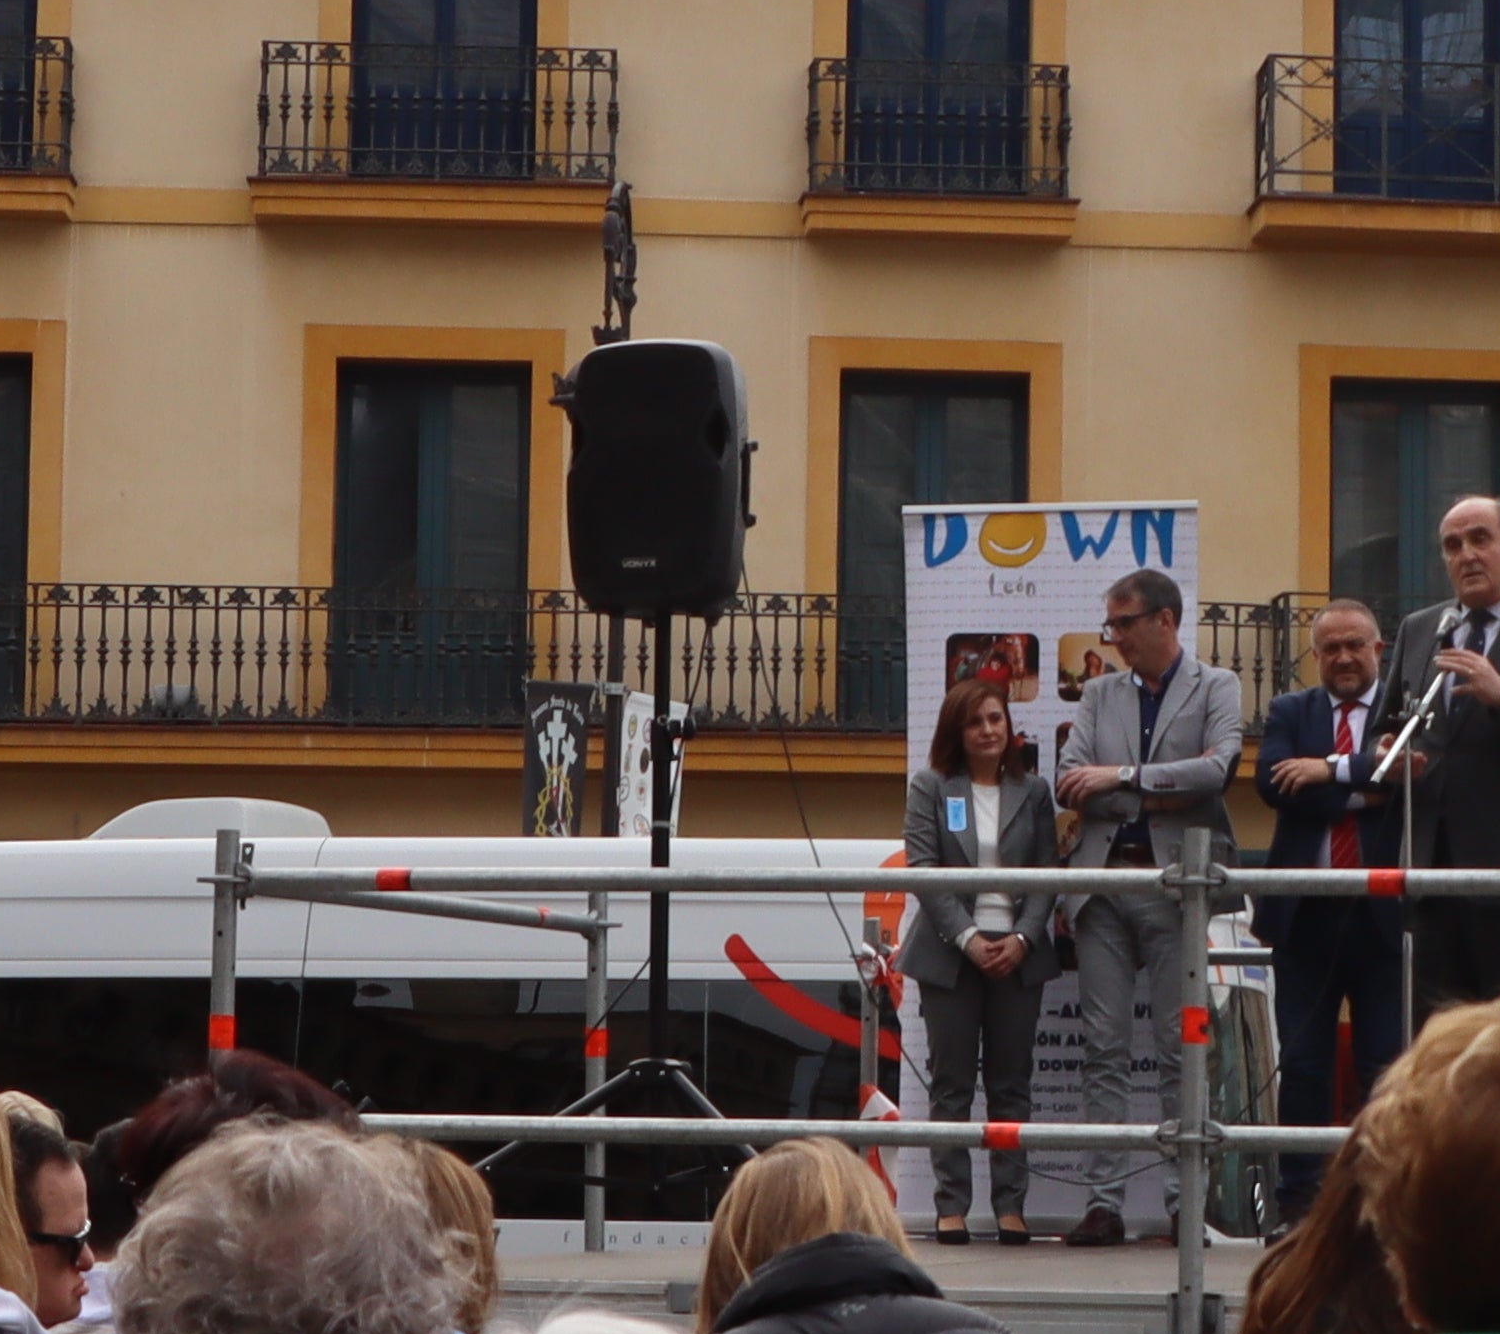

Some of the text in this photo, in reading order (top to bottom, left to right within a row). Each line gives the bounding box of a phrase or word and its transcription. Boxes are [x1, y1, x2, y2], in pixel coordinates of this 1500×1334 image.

[922, 508, 1176, 568] DOWN
[988, 573, 1037, 596] León
[1052, 1102, 1078, 1114] León
